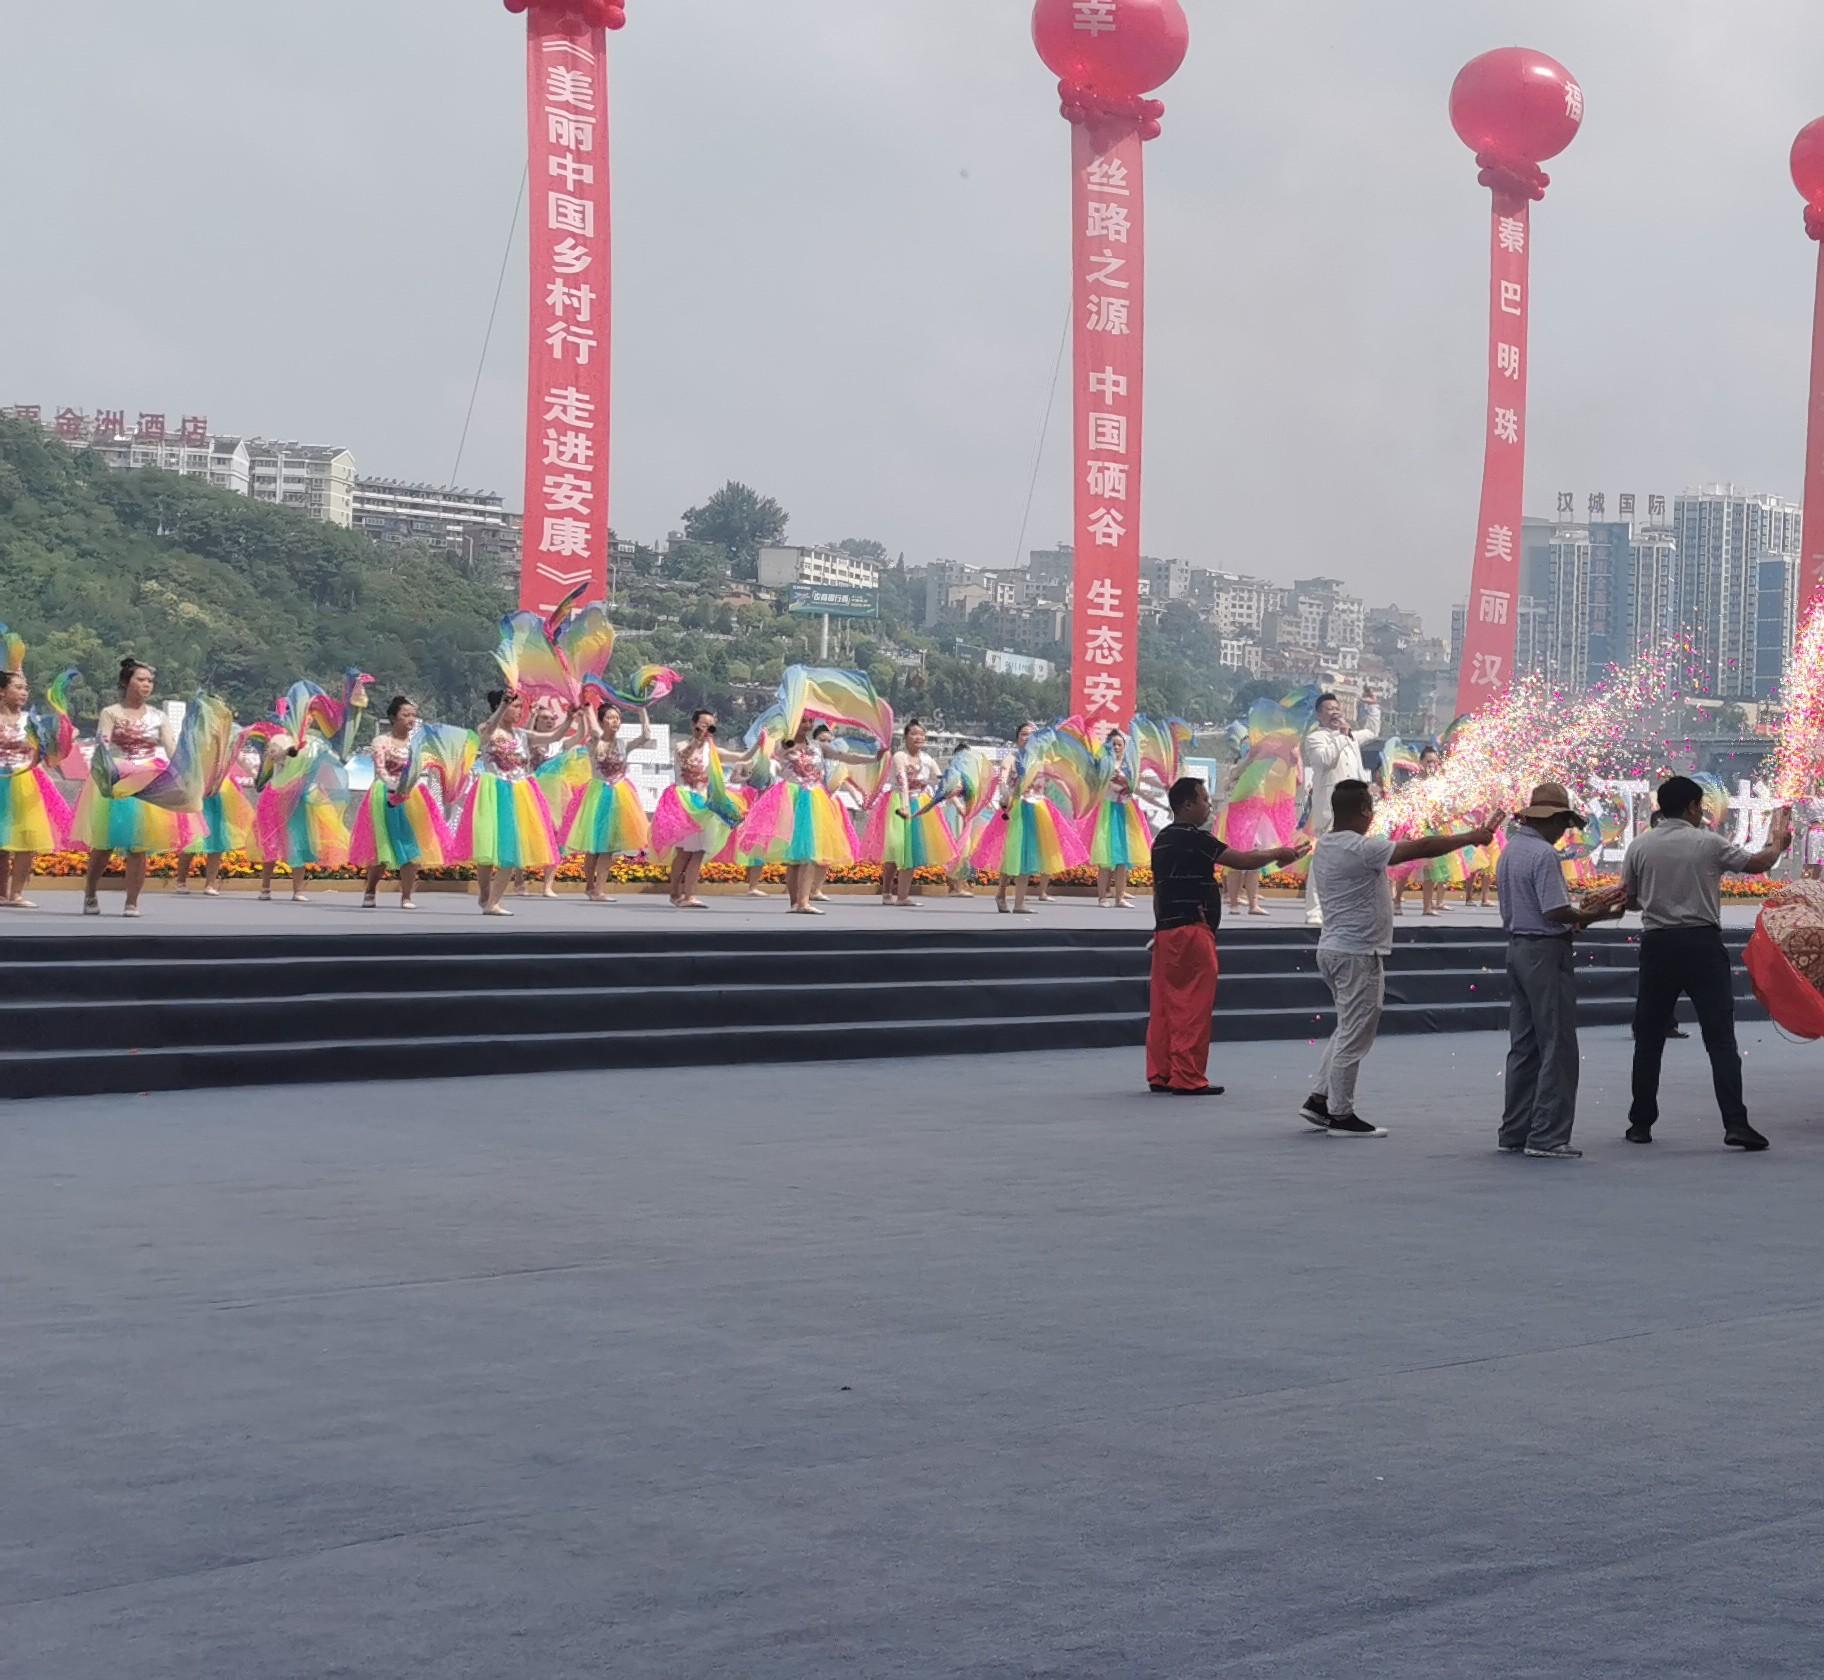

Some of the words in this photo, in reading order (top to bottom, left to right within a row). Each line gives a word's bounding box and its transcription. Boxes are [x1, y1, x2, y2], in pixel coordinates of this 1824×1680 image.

[1085, 158, 1130, 336] 丝路之源
[1494, 216, 1525, 443] 秦巴明珠
[1085, 365, 1128, 548] 中国硒谷
[1557, 491, 1665, 515] 汉城国际
